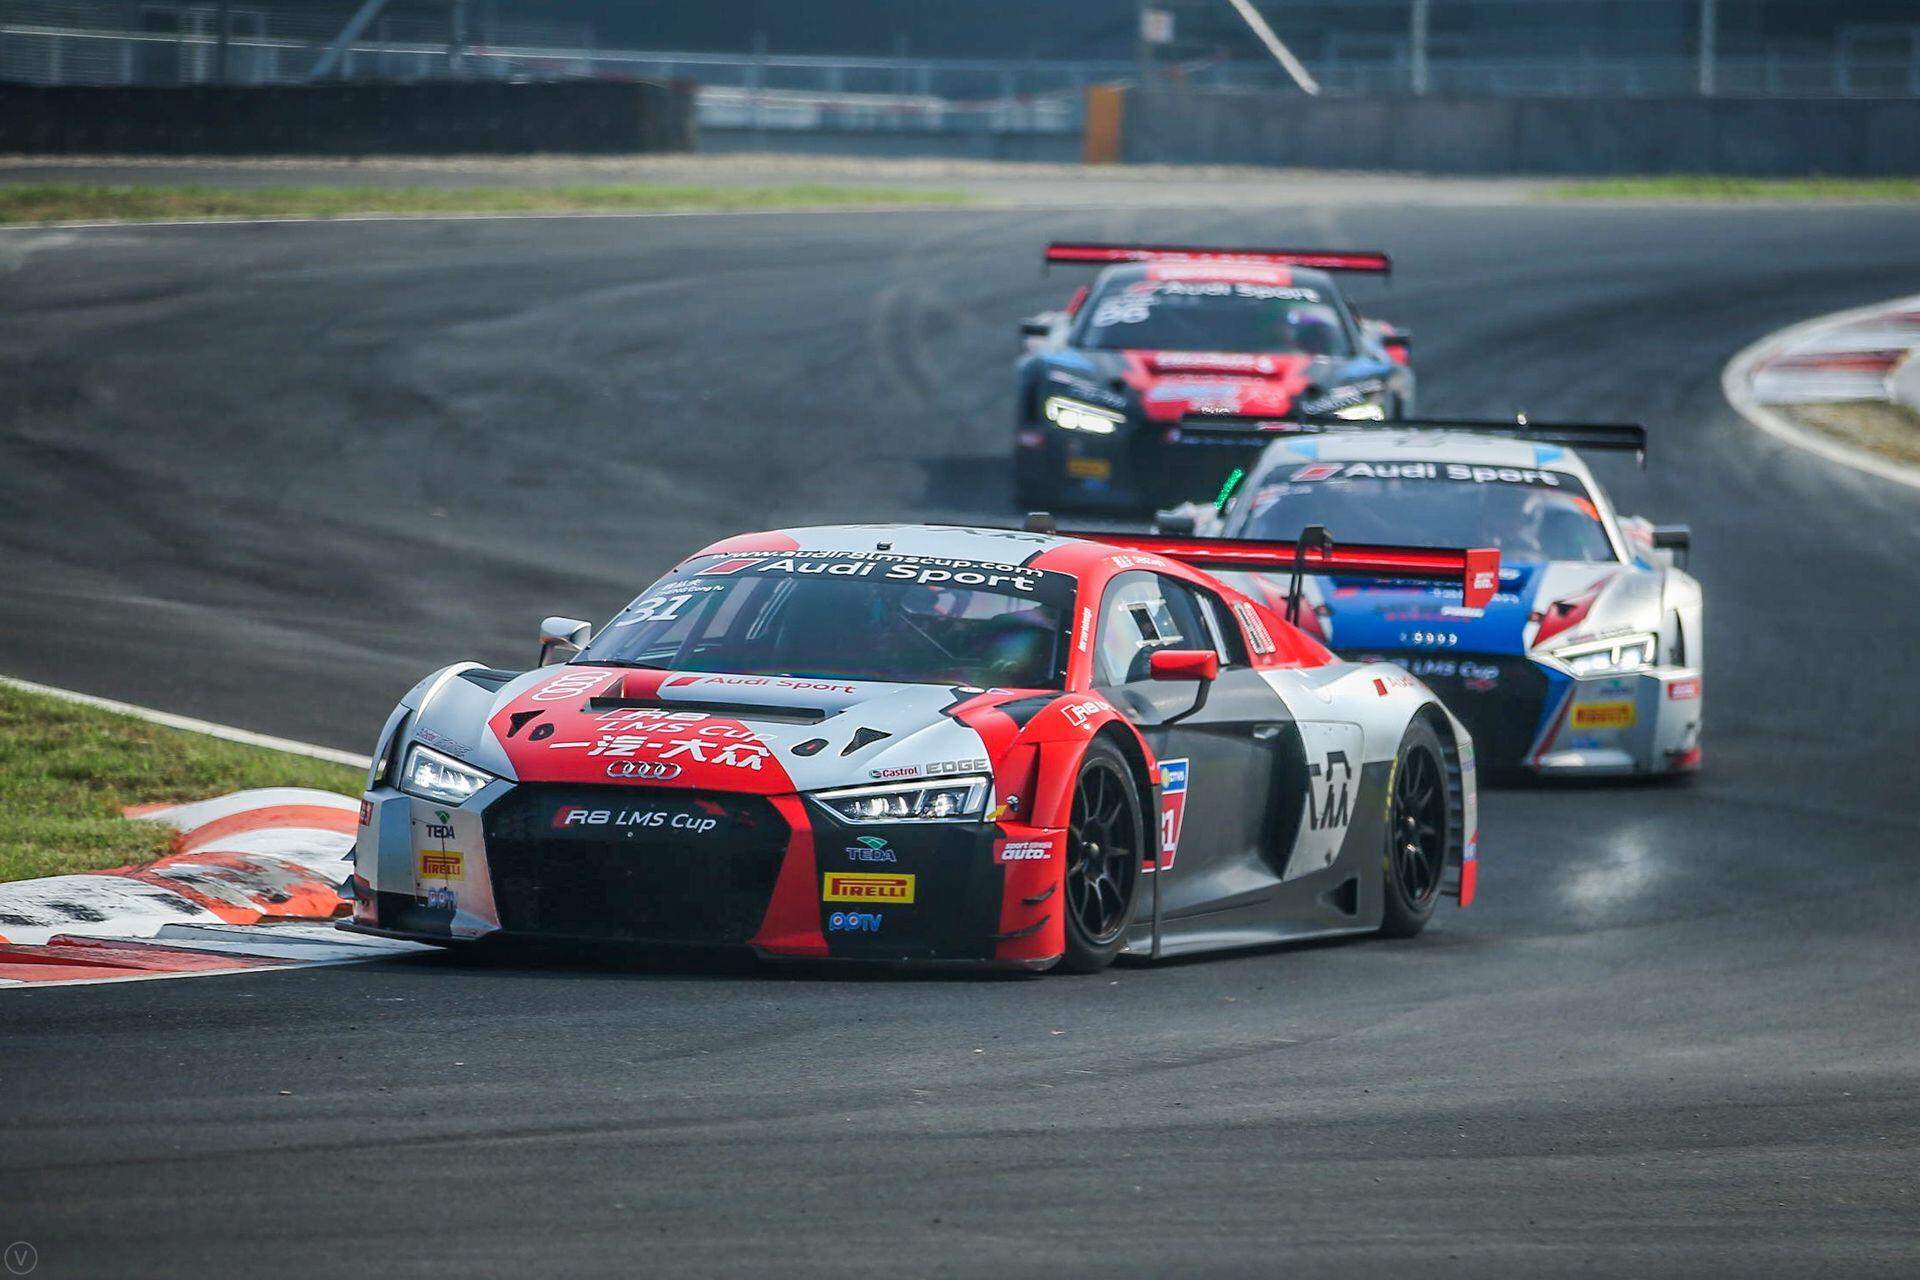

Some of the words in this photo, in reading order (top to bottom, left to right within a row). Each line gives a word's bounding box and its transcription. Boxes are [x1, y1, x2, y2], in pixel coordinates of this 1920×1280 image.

[1162, 281, 1231, 296] Audi
[1234, 284, 1320, 302] Sport
[1345, 462, 1436, 479] Audi
[1446, 464, 1560, 486] Sport
[712, 550, 1045, 577] www.audir8lmscup.com
[758, 558, 877, 577] Audi
[885, 563, 1036, 592] Sport
[614, 594, 693, 627] 31
[702, 675, 771, 688] Audi
[776, 679, 857, 694] Sport
[621, 708, 711, 721] R8
[597, 721, 694, 733] LMS
[882, 766, 918, 778] Castrol
[926, 759, 988, 774] EDGE
[564, 810, 612, 825] R8
[615, 811, 668, 827] LMS
[671, 813, 717, 834] Cup
[426, 825, 455, 839] TEDA
[845, 847, 897, 862] TEDA
[423, 855, 461, 875] PIRELLI
[831, 878, 907, 897] PIRELLI
